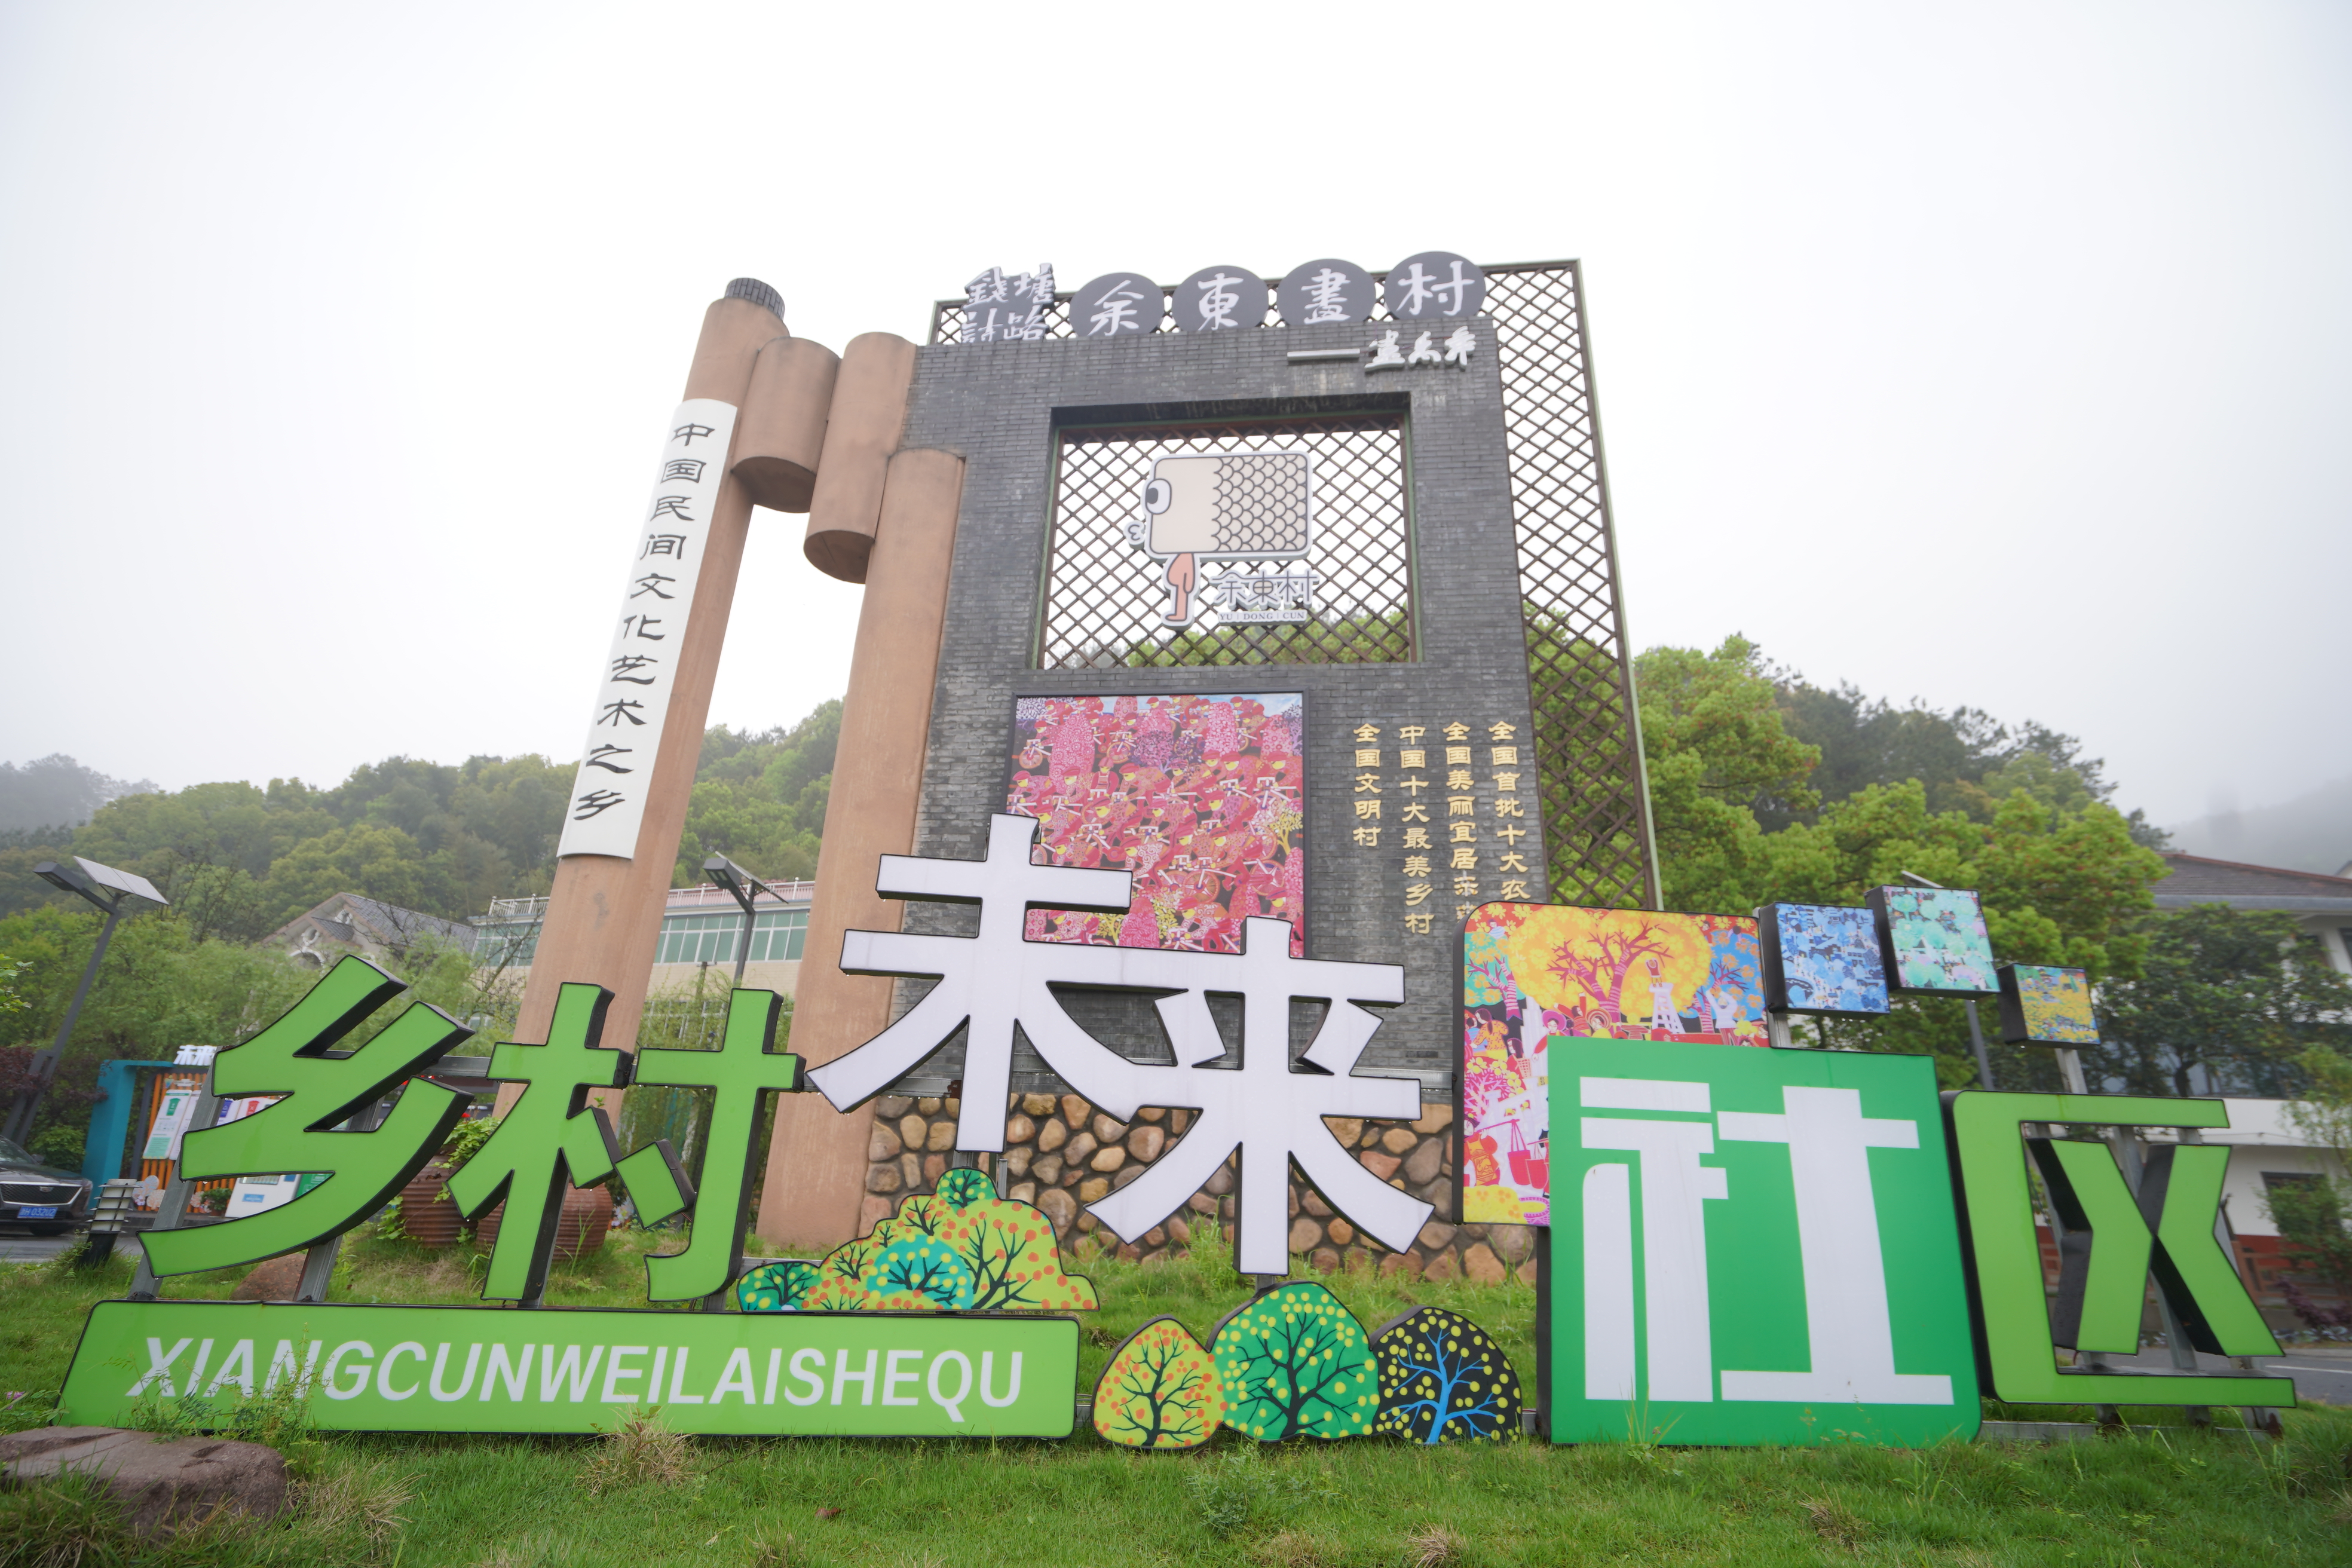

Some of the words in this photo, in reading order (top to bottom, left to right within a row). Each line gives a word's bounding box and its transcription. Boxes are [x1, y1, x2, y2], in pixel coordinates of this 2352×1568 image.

[572, 422, 716, 821] 中国民间文化艺术之乡
[1352, 722, 1383, 847] 全国文明村
[1399, 725, 1435, 935] 中国十大最美乡村
[1488, 721, 1532, 901] 全国首批十大农
[124, 1336, 1024, 1423] XIANGCUNWEILAISHEQU
